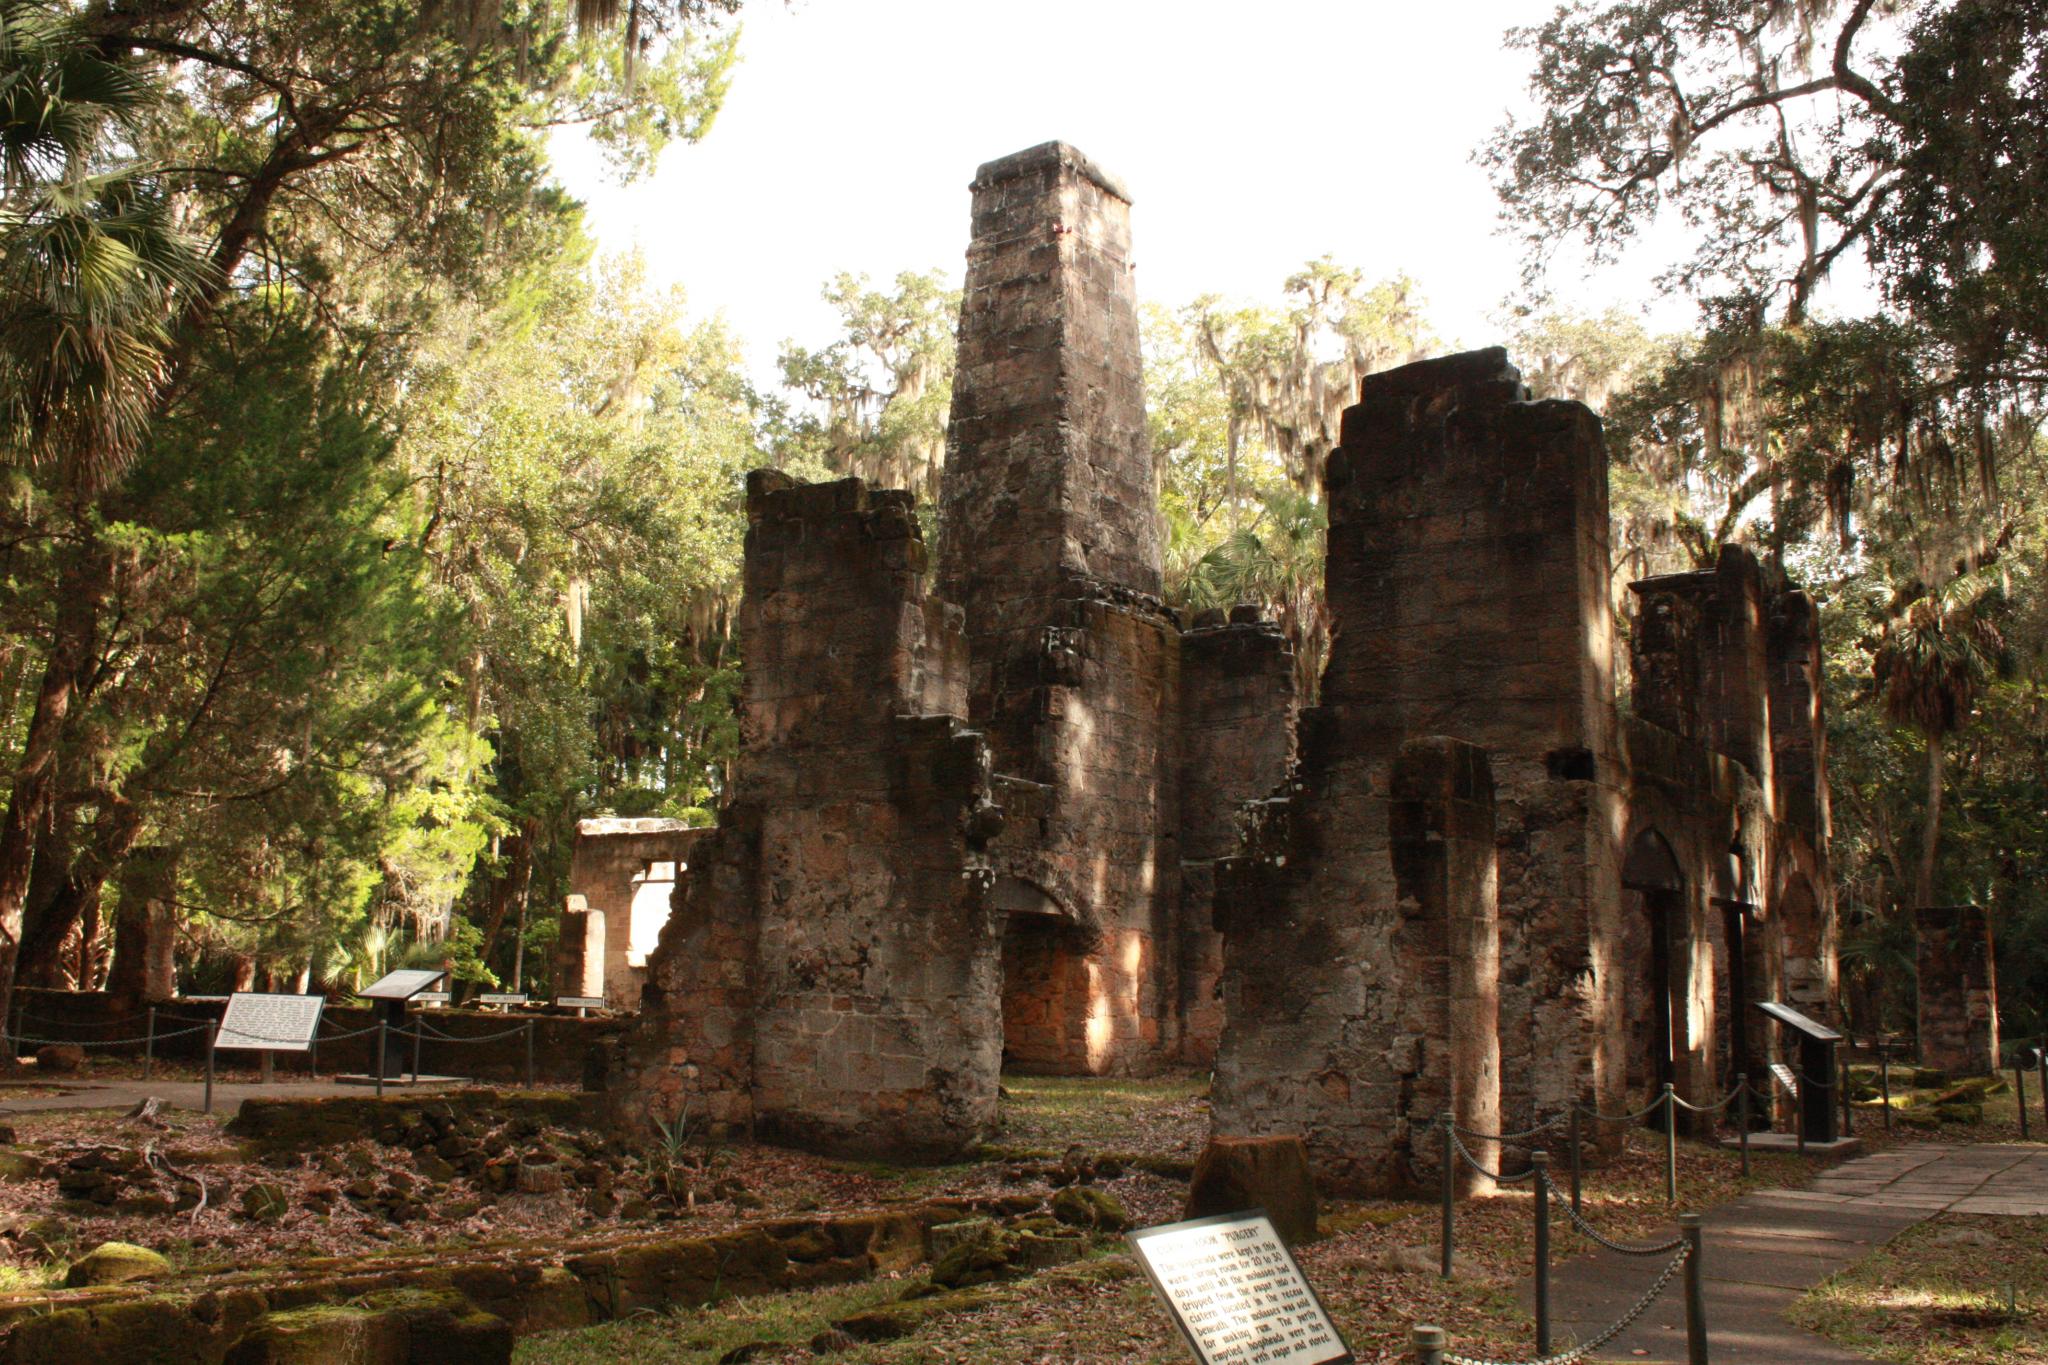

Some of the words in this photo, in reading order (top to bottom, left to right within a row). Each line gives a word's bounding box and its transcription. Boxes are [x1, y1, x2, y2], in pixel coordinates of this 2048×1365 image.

[1221, 1226, 1259, 1241] "PURGERY"
[1236, 1246, 1253, 1257] kept
[1252, 1243, 1261, 1253] in
[1261, 1240, 1276, 1250] this
[1219, 1263, 1238, 1272] room
[1238, 1258, 1250, 1268] for
[1251, 1255, 1262, 1265] 20
[1263, 1255, 1271, 1263] to
[1271, 1252, 1282, 1261] 30
[1175, 1288, 1193, 1298] days
[1218, 1278, 1229, 1287] all
[1231, 1274, 1244, 1284] the
[1246, 1268, 1275, 1279] molasses
[1276, 1264, 1290, 1273] had
[1182, 1296, 1214, 1310] dripped
[1237, 1286, 1251, 1296] the
[1189, 1309, 1219, 1323] cistern
[1265, 1293, 1279, 1302] the
[1281, 1288, 1304, 1298] recess
[1232, 1315, 1249, 1325] The
[1250, 1307, 1281, 1320] molasses
[1203, 1338, 1217, 1349] for
[1222, 1330, 1252, 1343] making
[1277, 1316, 1293, 1327] The
[1212, 1344, 1244, 1362] emptied
[1288, 1328, 1306, 1338] were
[1251, 1351, 1270, 1364] with
[1272, 1346, 1291, 1358] sugar
[1293, 1340, 1307, 1351] and
